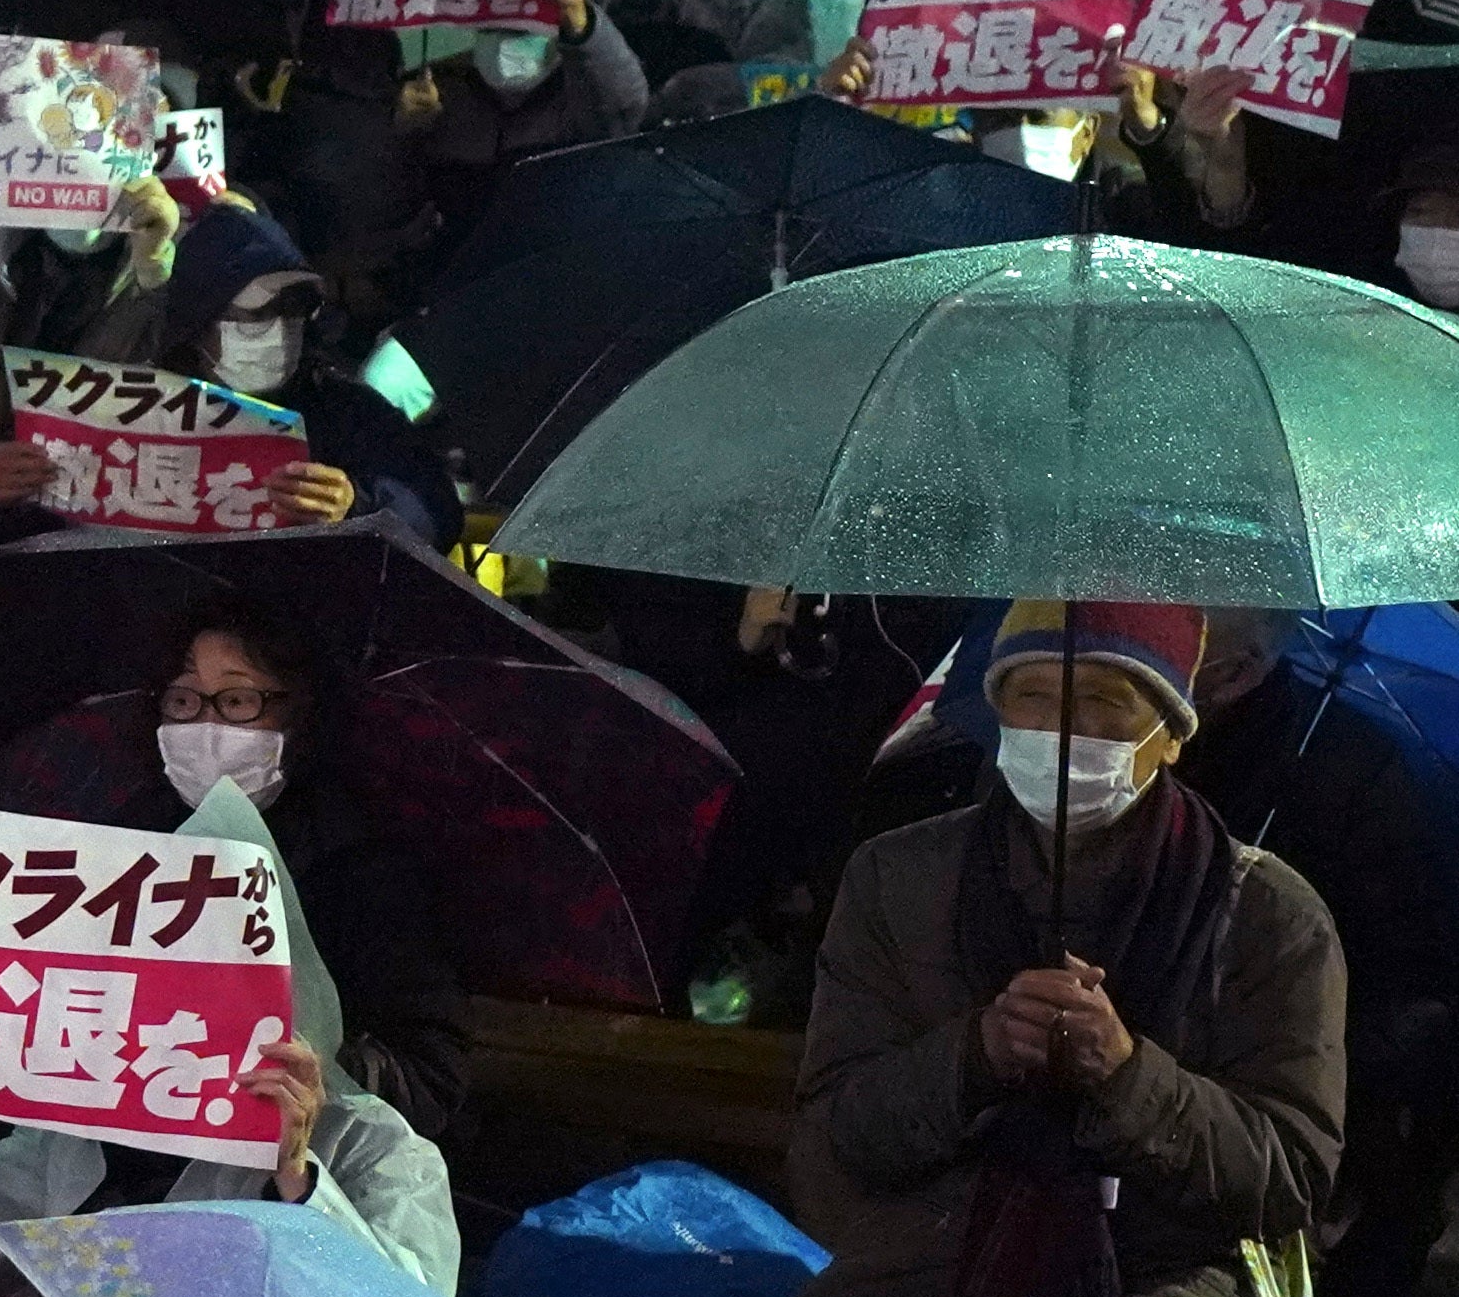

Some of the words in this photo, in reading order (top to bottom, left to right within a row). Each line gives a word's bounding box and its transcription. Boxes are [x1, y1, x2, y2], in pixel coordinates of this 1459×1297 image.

[868, 8, 1112, 97] 撤退を!
[14, 186, 49, 205] NO
[53, 188, 103, 207] WAR
